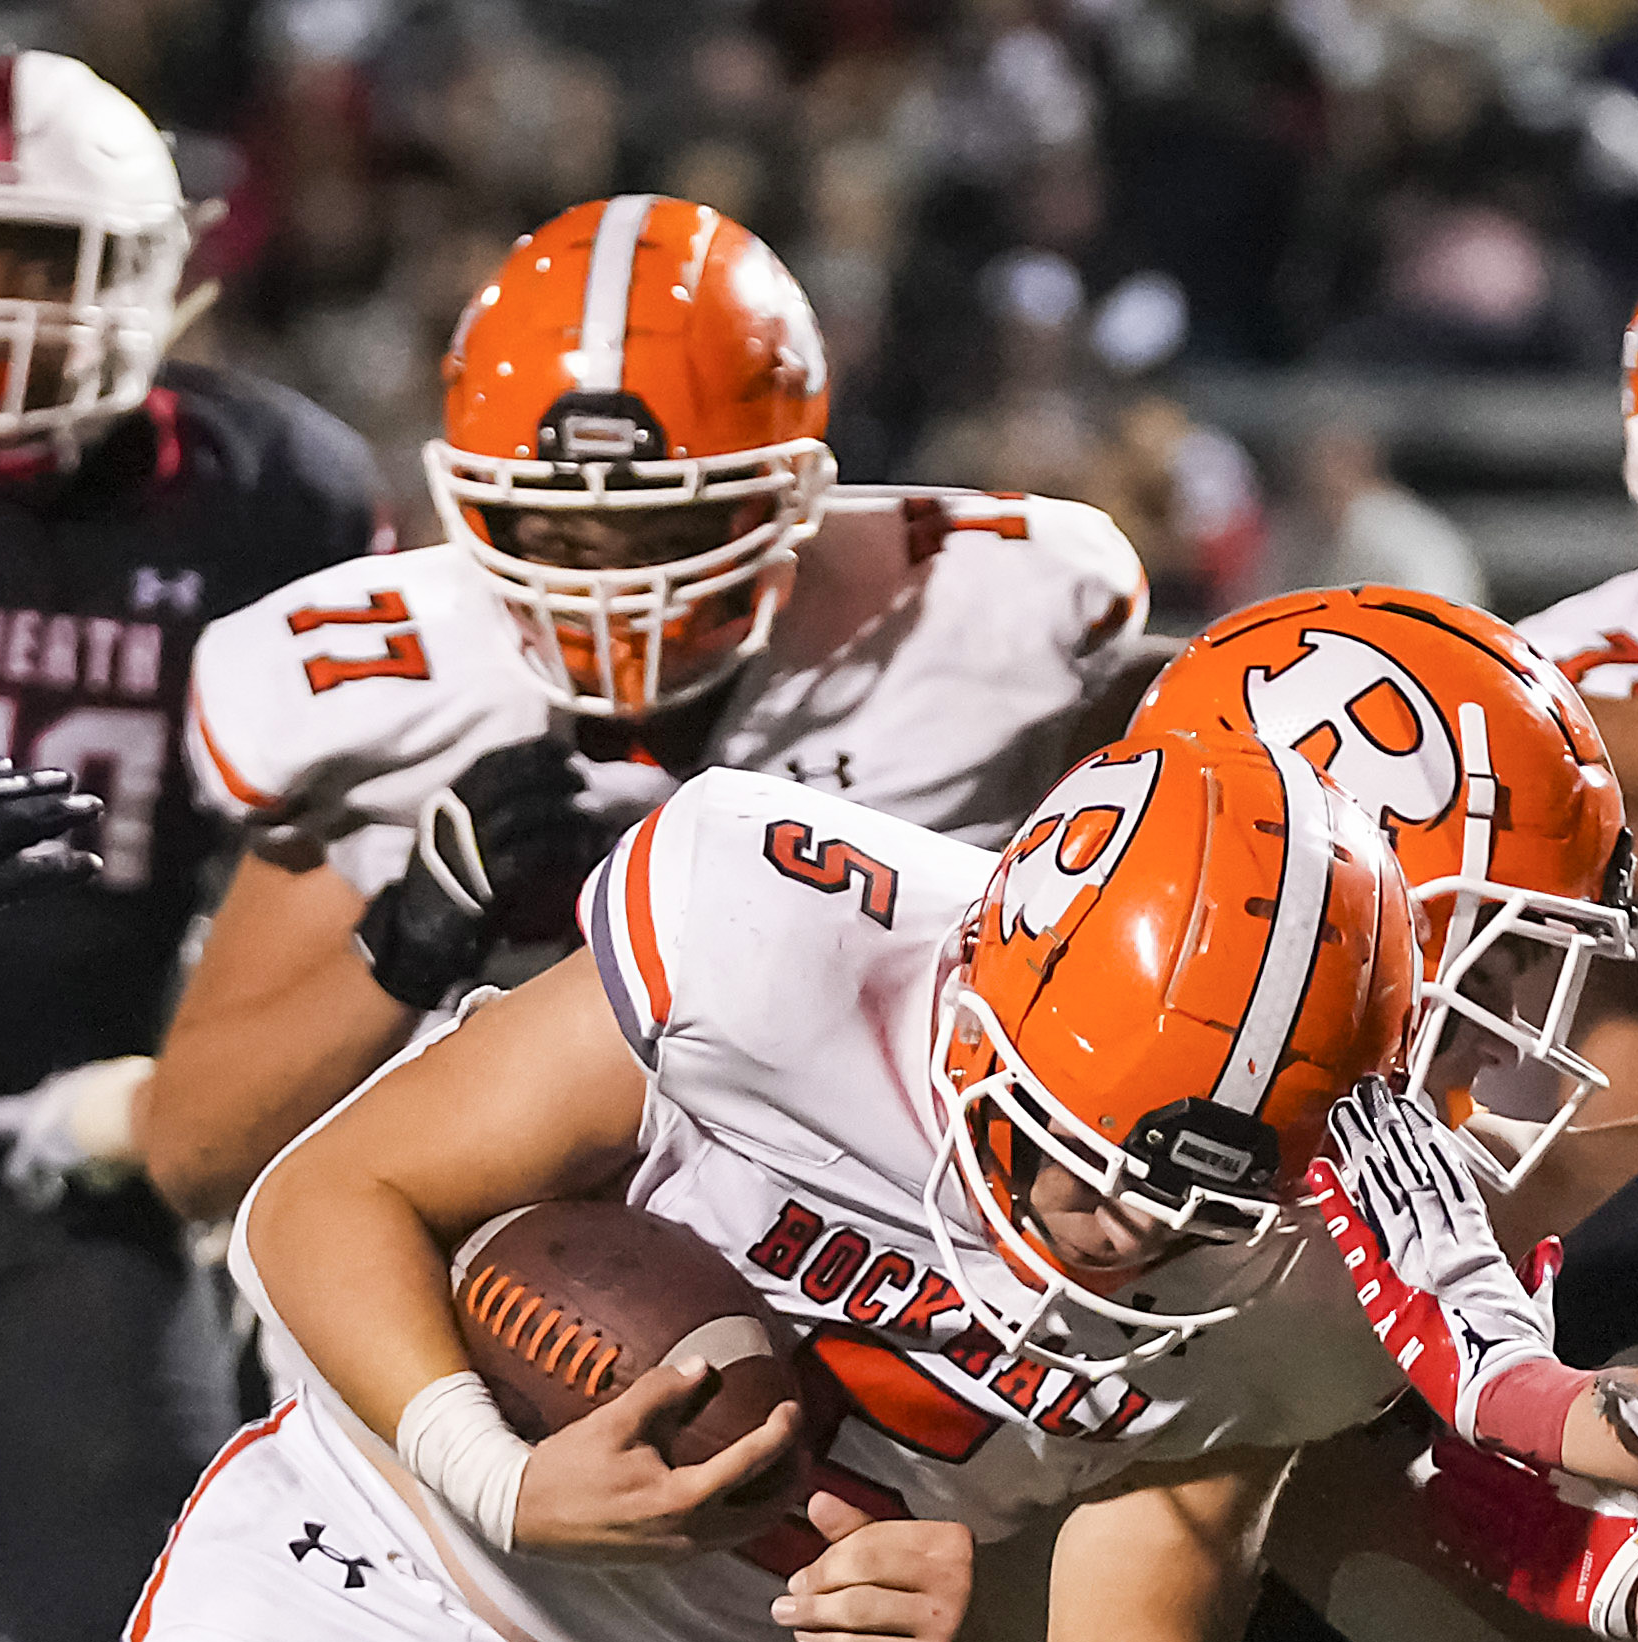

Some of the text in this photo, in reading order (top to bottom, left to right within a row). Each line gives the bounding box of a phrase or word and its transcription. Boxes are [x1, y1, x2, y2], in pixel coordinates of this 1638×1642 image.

[287, 590, 431, 696] 77
[762, 819, 899, 932] 5
[1316, 1187, 1426, 1373] JORDAN
